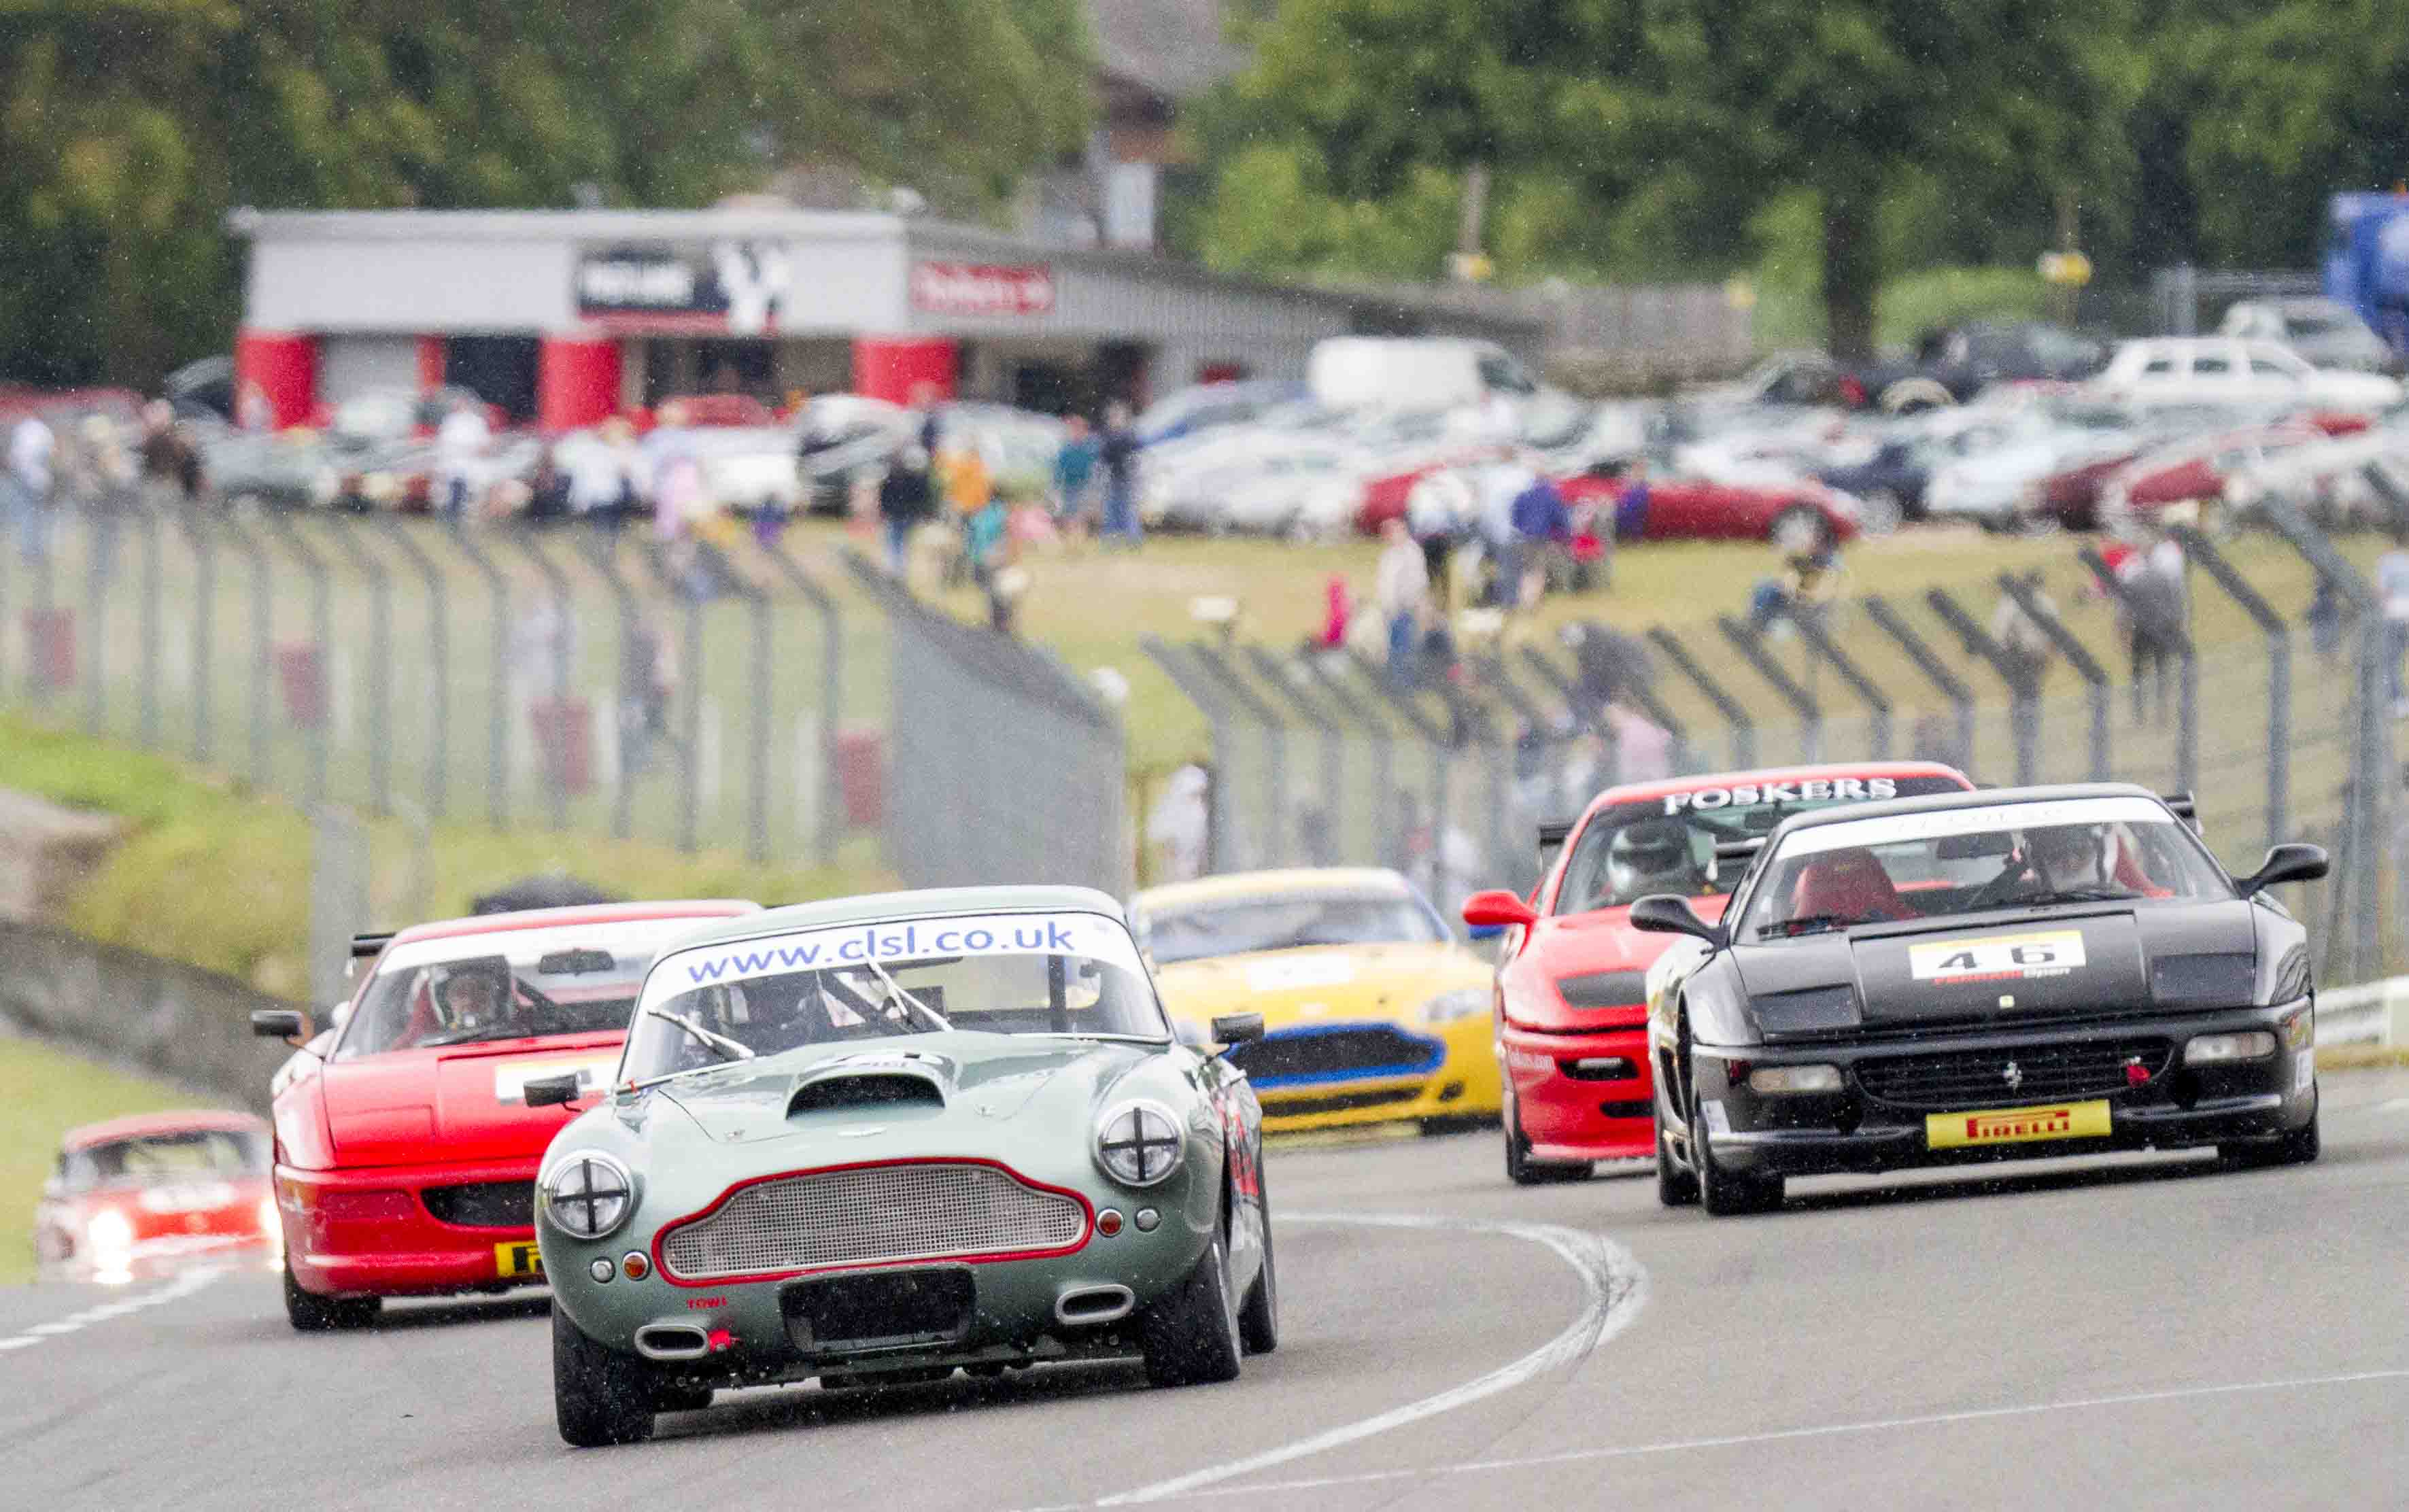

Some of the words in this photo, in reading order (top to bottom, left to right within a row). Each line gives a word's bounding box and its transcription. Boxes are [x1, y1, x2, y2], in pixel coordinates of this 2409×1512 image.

[1663, 777, 1897, 815] FOSKERS
[687, 920, 1076, 983] www.clsl.co.uk
[1966, 1110, 2069, 1139] PIRELLI
